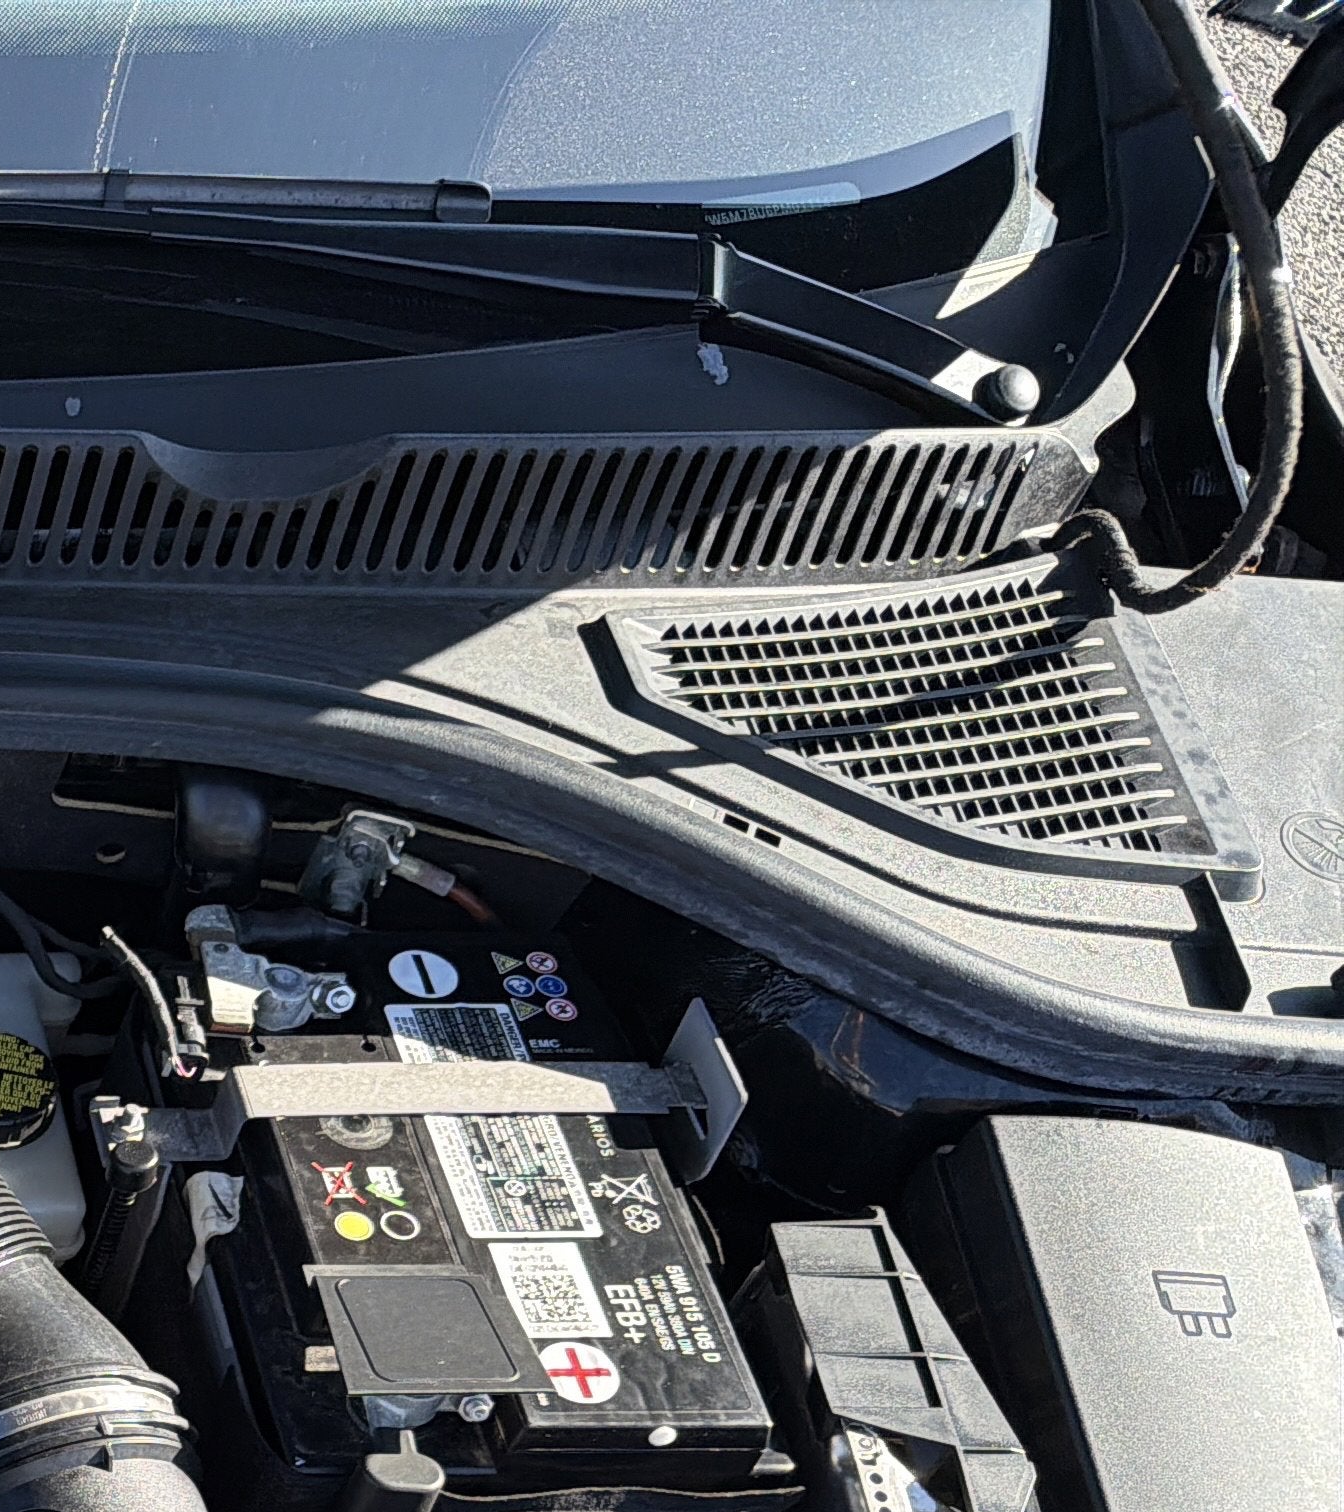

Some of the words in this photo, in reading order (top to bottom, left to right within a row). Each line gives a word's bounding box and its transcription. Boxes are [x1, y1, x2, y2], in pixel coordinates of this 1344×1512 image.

[20, 1043, 35, 1053] CAP
[586, 1115, 616, 1158] ARIOS
[665, 1264, 687, 1294] 5WA
[603, 1284, 648, 1344] EFB+
[679, 1296, 705, 1322] 915
[691, 1324, 716, 1351] 105
[702, 1352, 722, 1363] D
